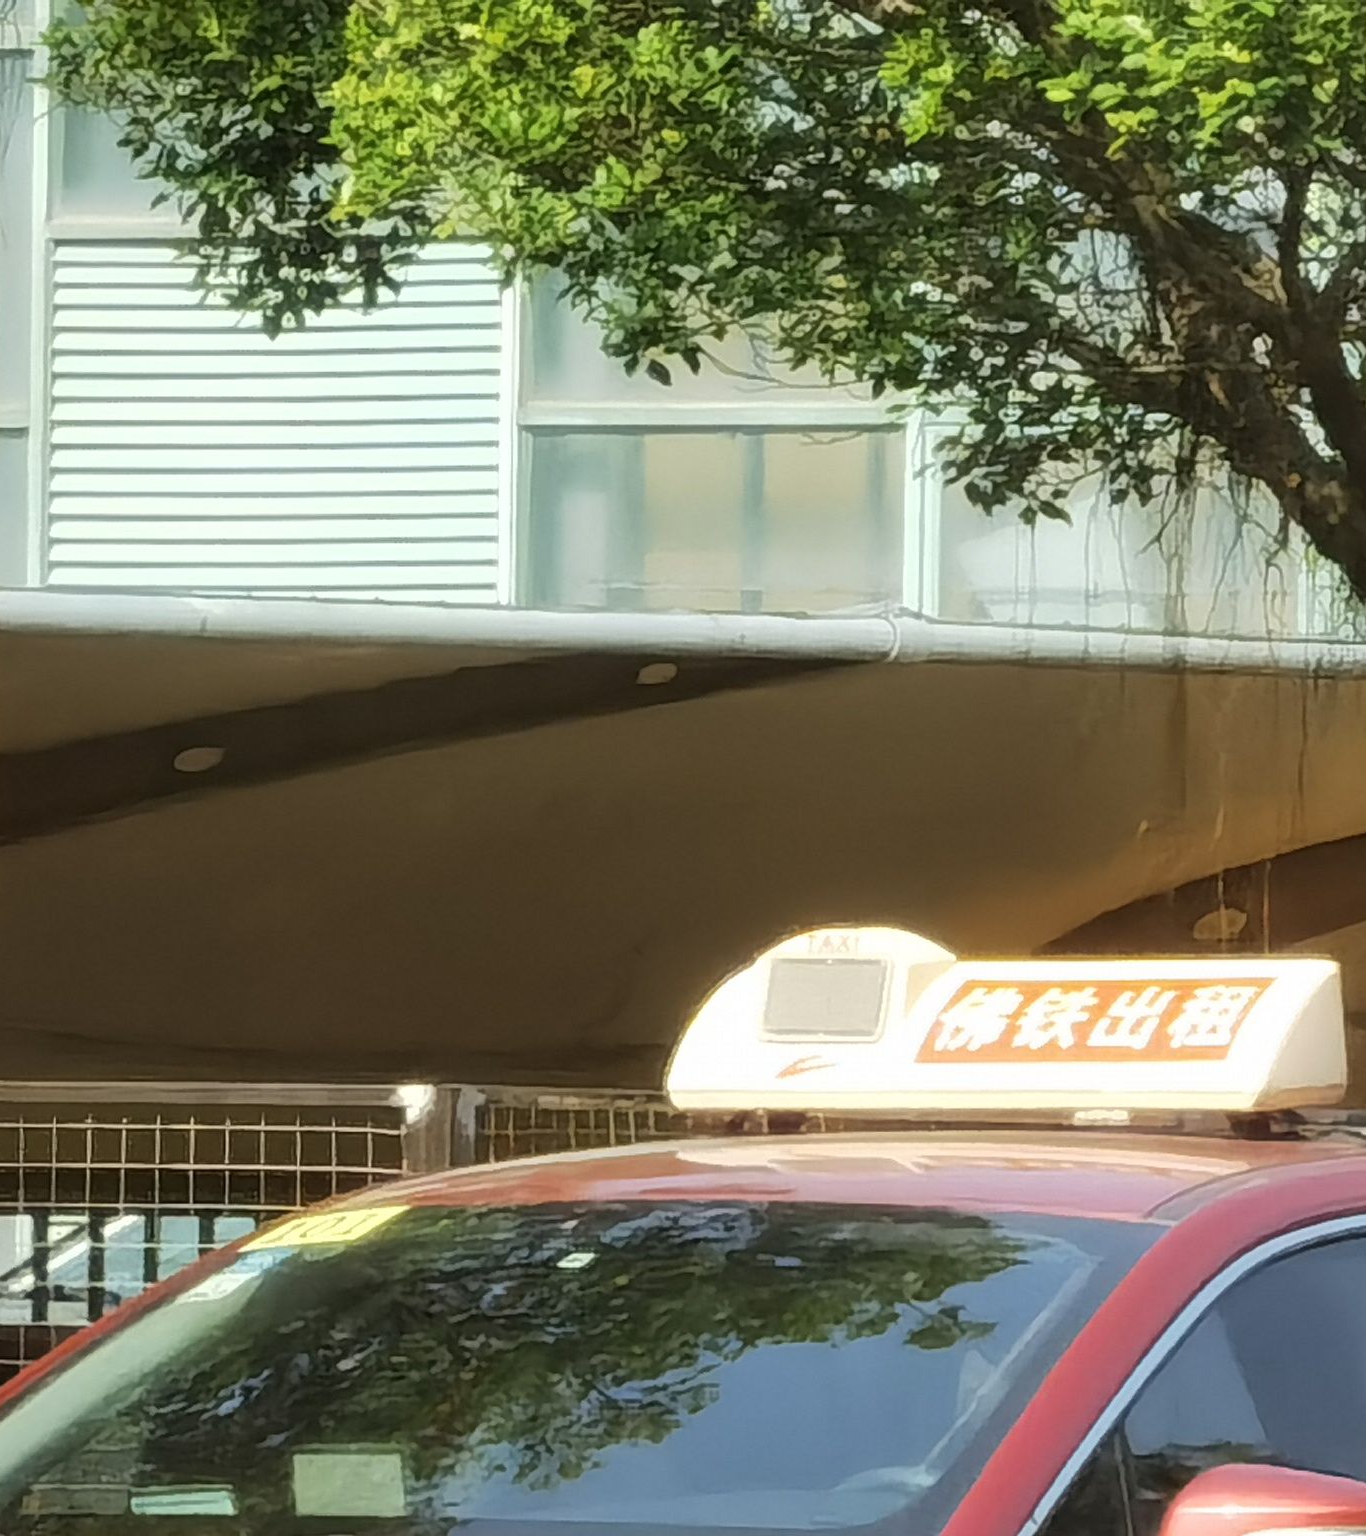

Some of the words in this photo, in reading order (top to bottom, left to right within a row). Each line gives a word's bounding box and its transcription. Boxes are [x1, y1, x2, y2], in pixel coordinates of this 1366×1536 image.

[807, 934, 859, 956] TAXI
[933, 985, 1262, 1052] 佛铁出租
